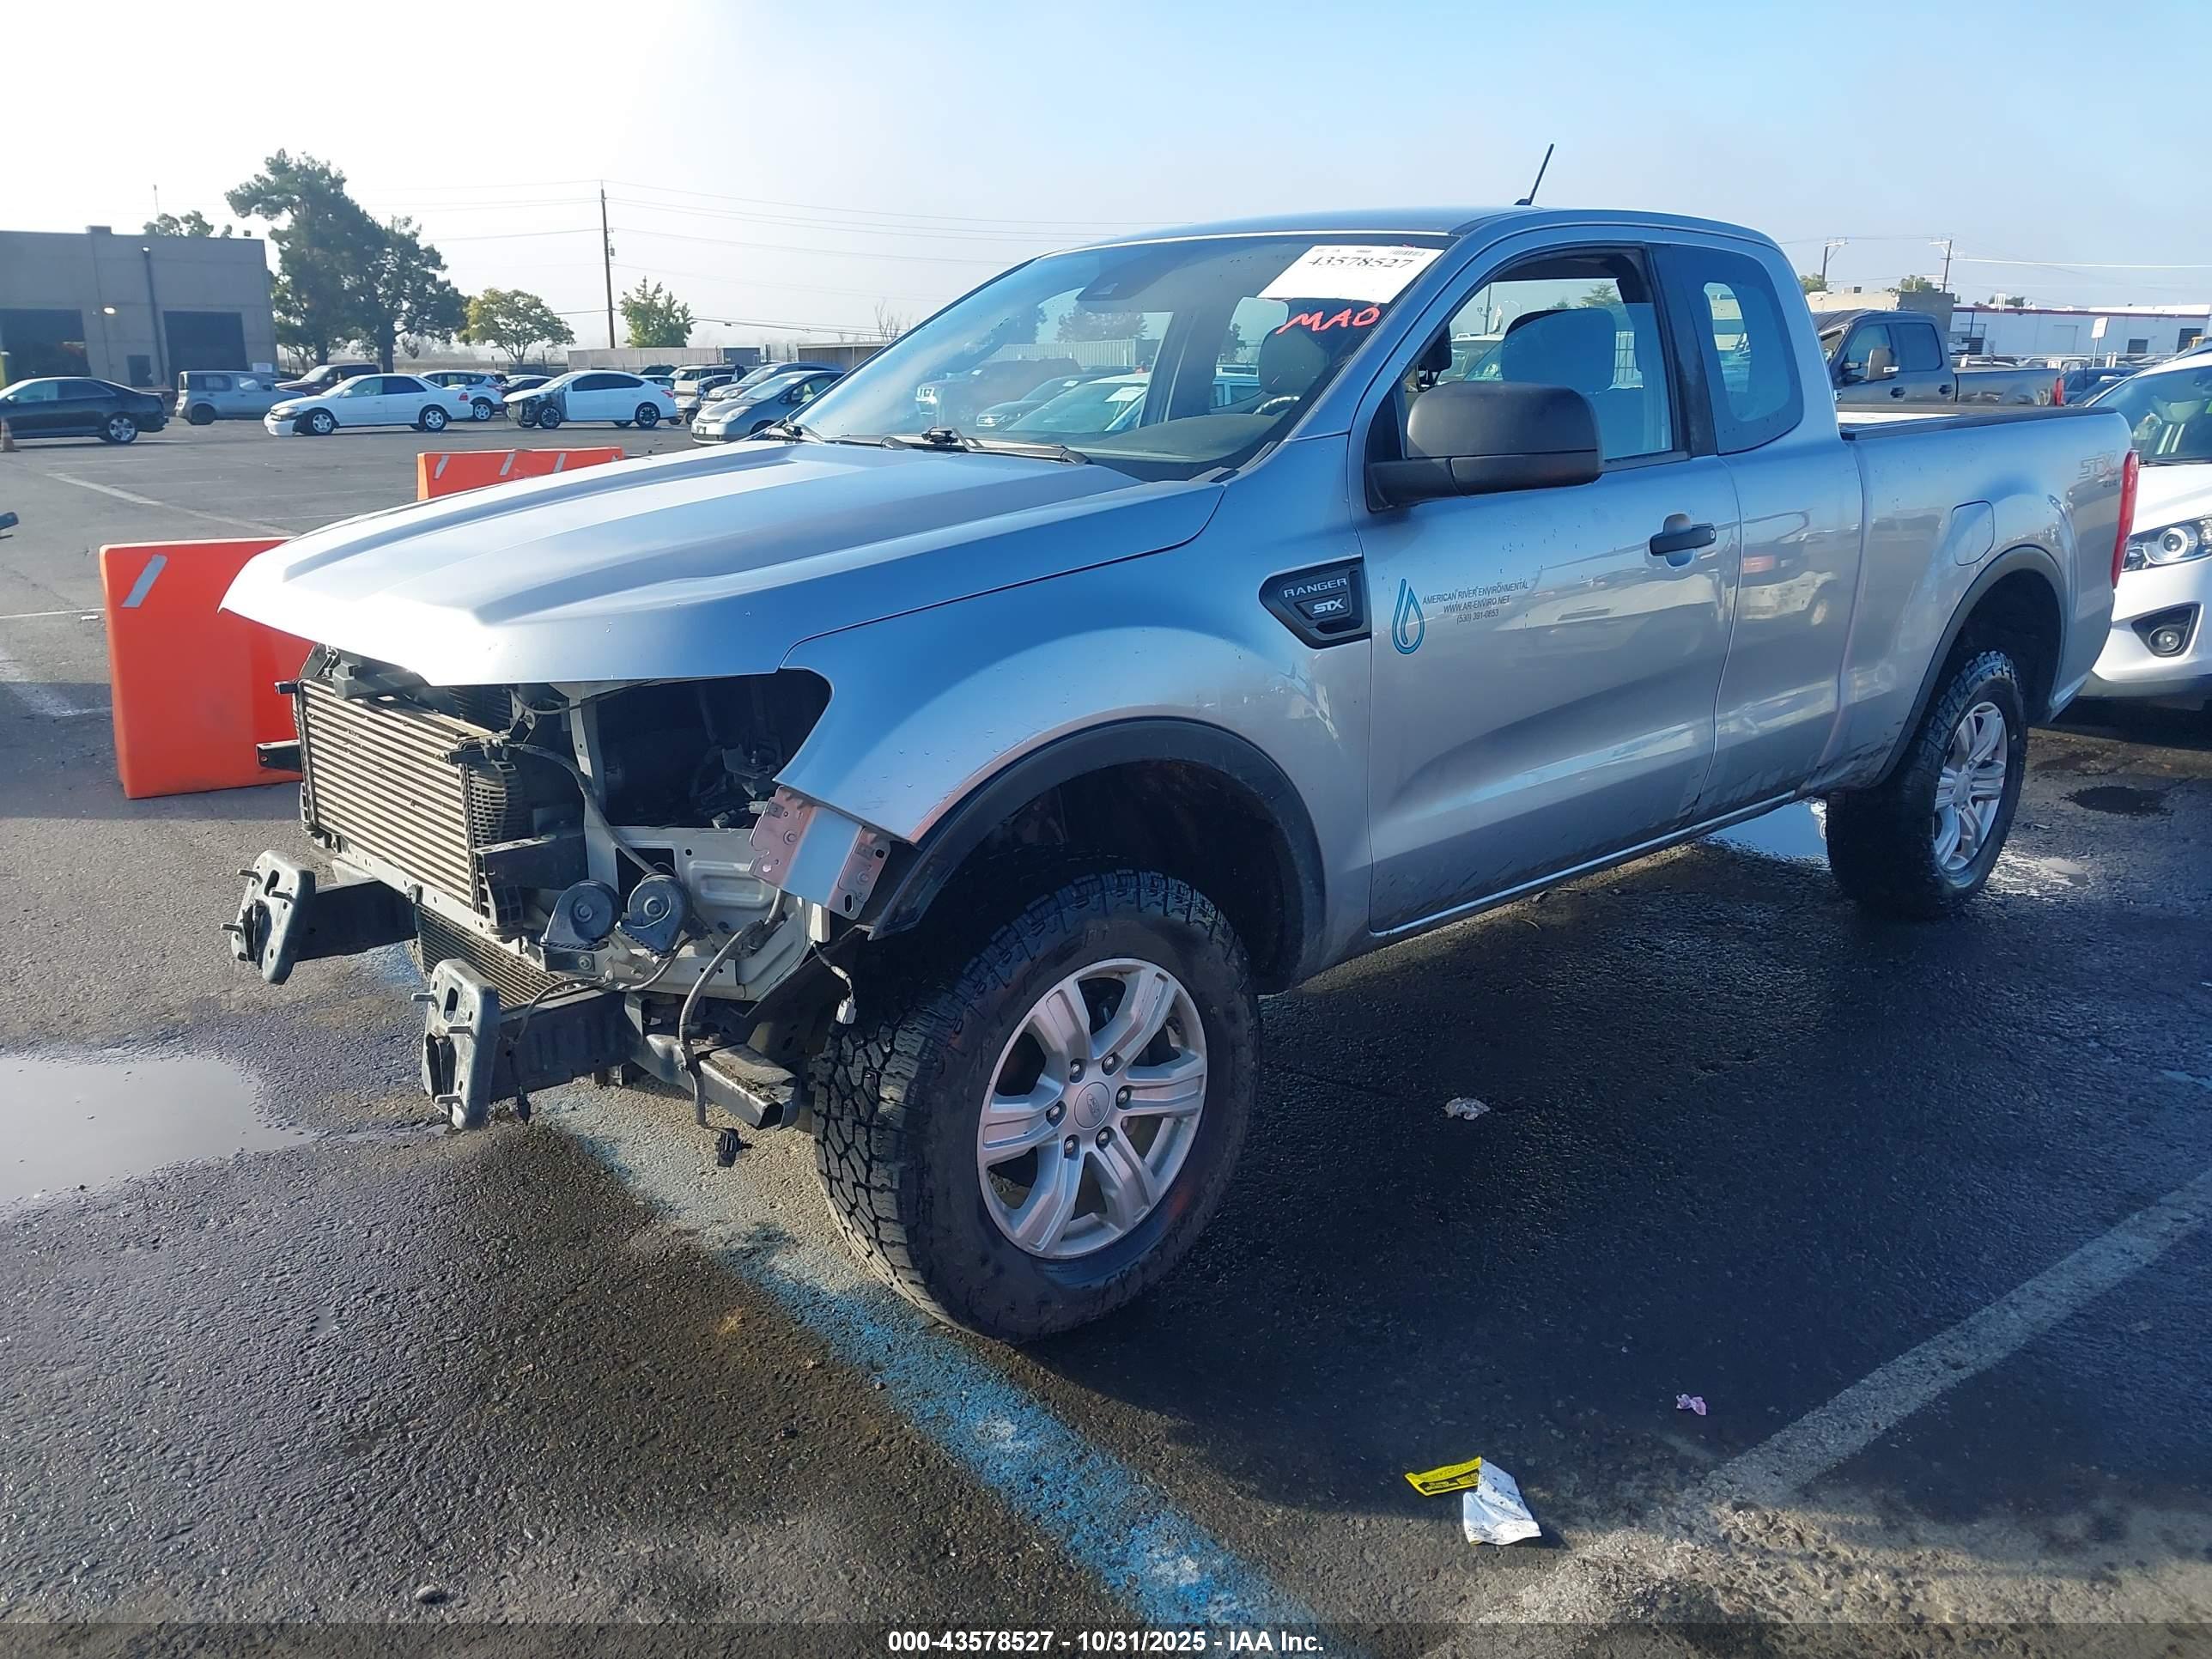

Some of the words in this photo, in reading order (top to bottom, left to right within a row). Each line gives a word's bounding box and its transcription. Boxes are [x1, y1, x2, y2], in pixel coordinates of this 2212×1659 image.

[1308, 256, 1414, 269] 43578527
[2078, 451, 2117, 479] STX
[1283, 578, 1347, 599] RANGER
[1422, 591, 1457, 605] AMERICAN
[1458, 587, 1478, 600] RIVER
[1478, 581, 1529, 597] ENVIRONMENTAL
[1312, 599, 1345, 615] STX
[1443, 595, 1511, 614] WWW.AR-ENVIRO.NET
[1456, 613, 1472, 625] (530)
